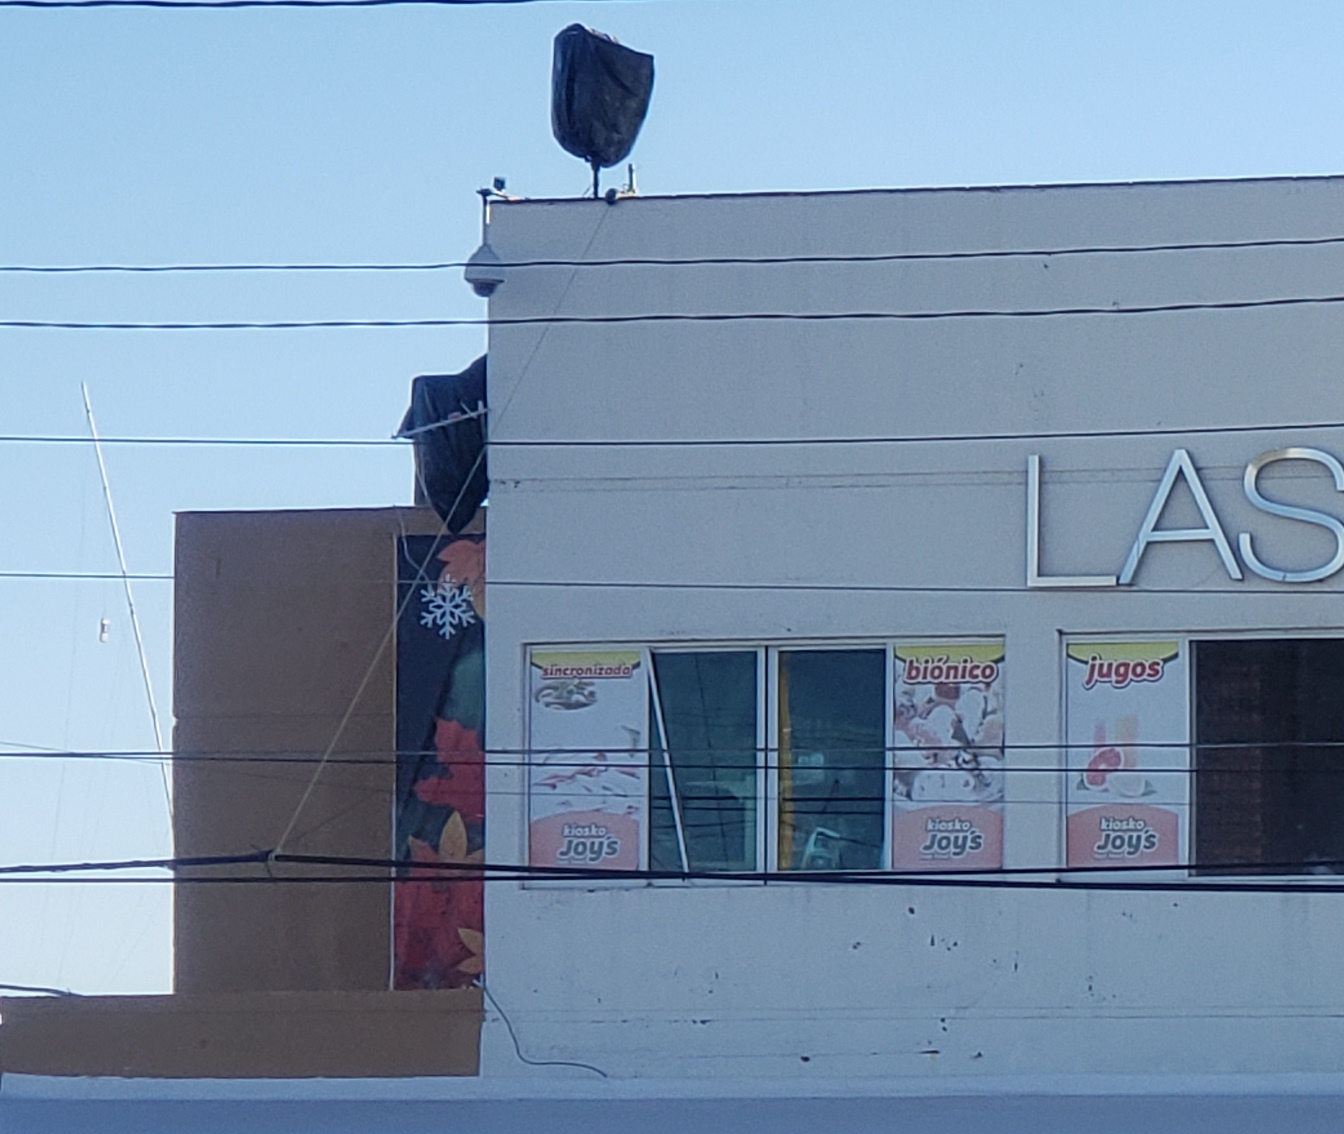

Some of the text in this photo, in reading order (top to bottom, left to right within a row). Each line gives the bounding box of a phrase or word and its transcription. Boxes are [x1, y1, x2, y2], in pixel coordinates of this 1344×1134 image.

[542, 662, 632, 677] sincronizada
[905, 658, 996, 683] biónico
[1086, 656, 1164, 687] jugos
[563, 825, 605, 837] kiosko
[926, 819, 971, 832] kiosko
[1101, 818, 1144, 831] kiosko
[559, 833, 618, 858] Joy's
[923, 829, 982, 854] Joy's
[1097, 828, 1157, 854] Joy's
